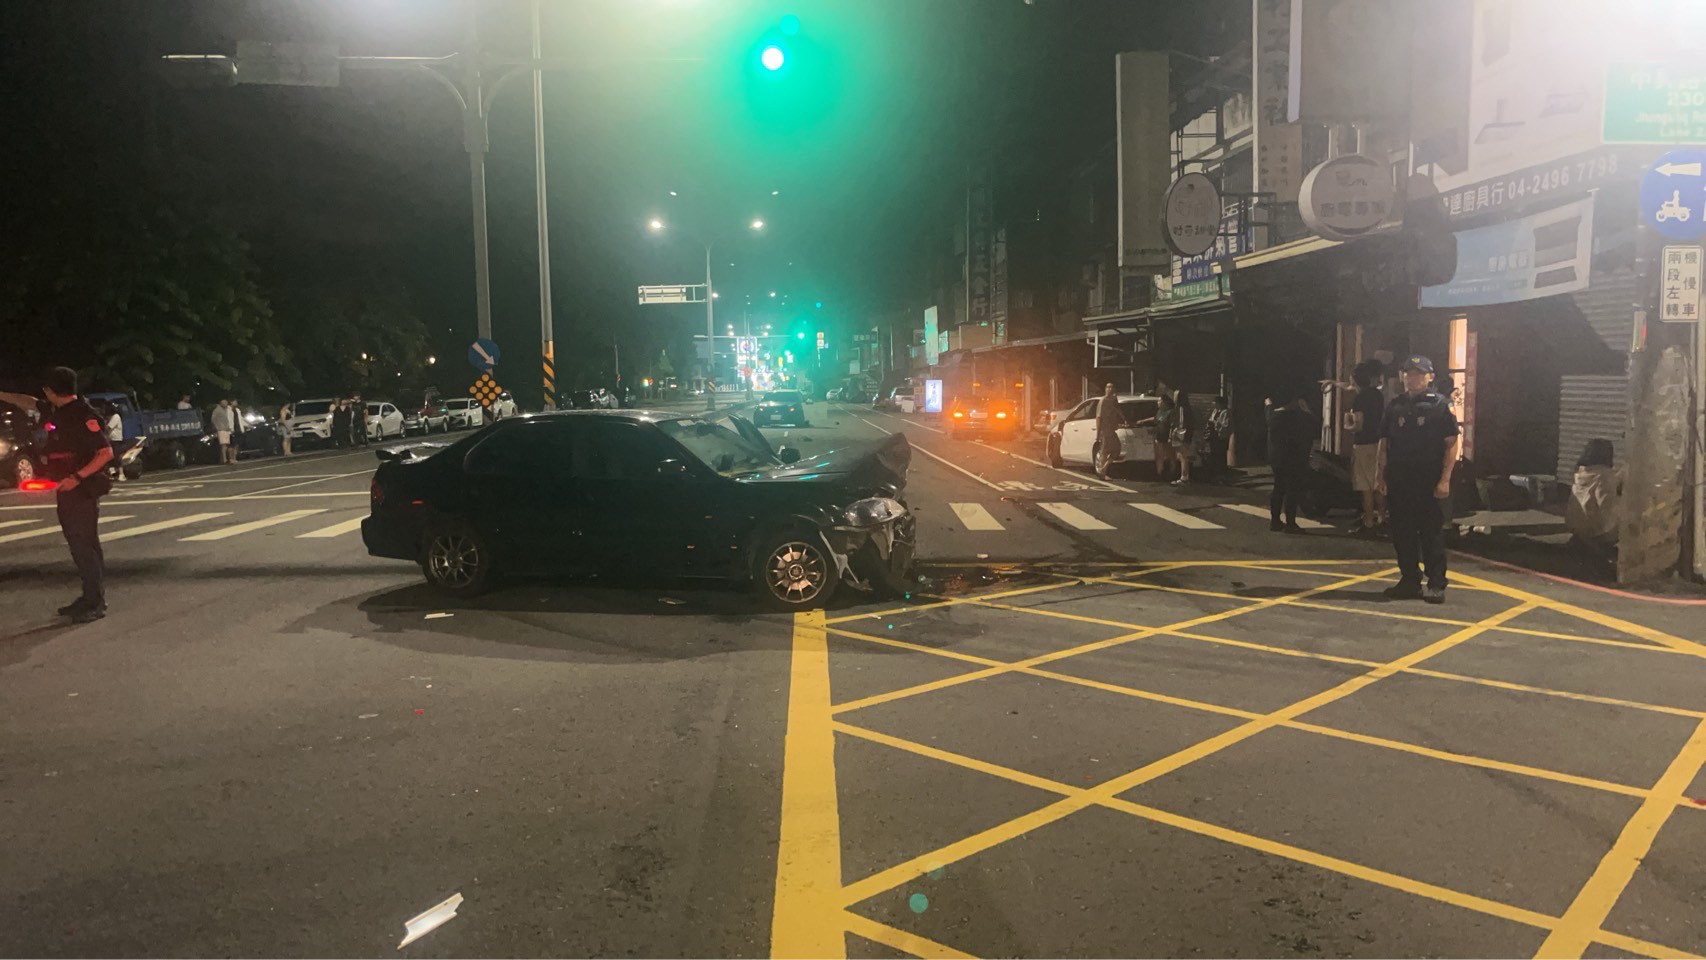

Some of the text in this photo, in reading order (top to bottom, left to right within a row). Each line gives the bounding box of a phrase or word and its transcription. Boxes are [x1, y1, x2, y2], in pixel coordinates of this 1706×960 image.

[1667, 92, 1705, 106] 230
[1508, 168, 1569, 199] 04-2496
[1577, 154, 1619, 184] 7798
[1666, 250, 1682, 317] 兩段左轉
[1682, 251, 1698, 317] 機慢車
